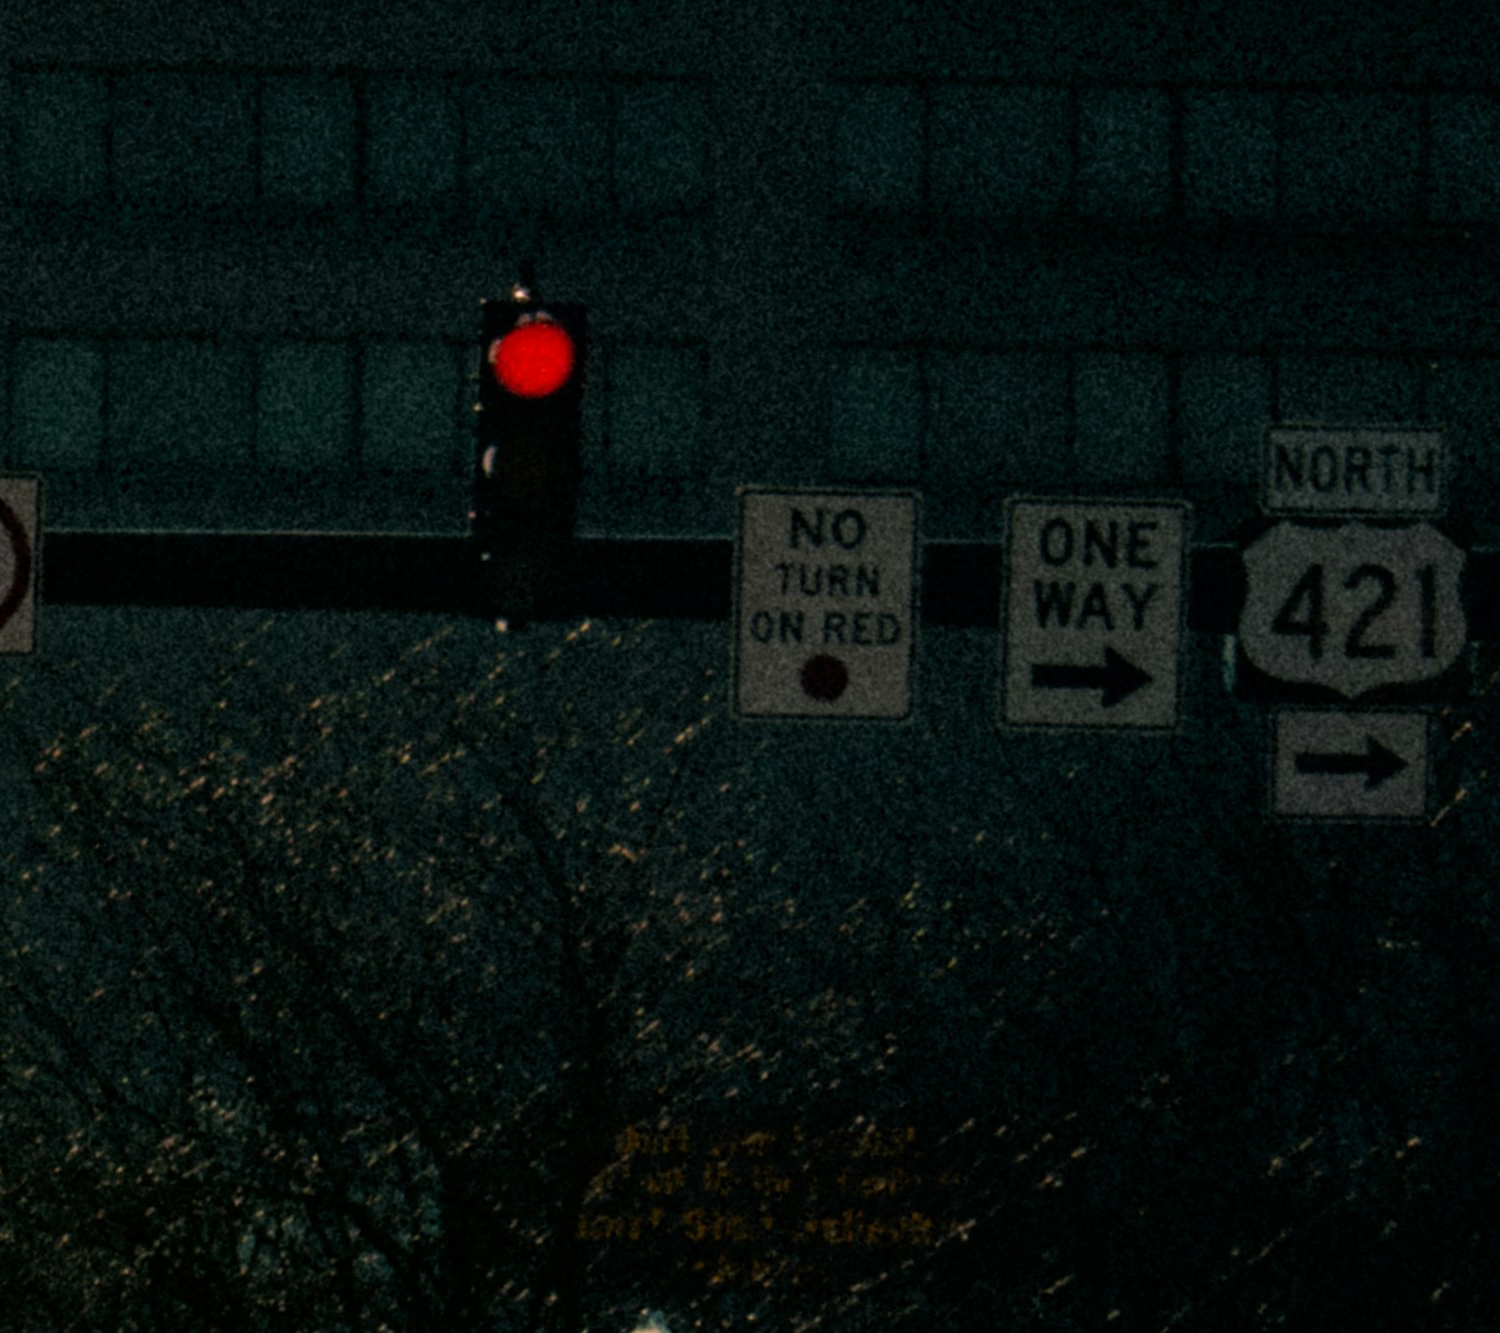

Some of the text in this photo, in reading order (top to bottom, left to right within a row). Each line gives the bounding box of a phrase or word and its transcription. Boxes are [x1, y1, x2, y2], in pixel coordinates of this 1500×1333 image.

[1273, 443, 1438, 494] NORTH
[788, 508, 867, 550] NO
[1039, 517, 1160, 570] ONE
[776, 563, 881, 598] TURN
[749, 610, 900, 648] ON RED
[1034, 582, 1161, 632] WAY
[1271, 563, 1438, 661] 421
